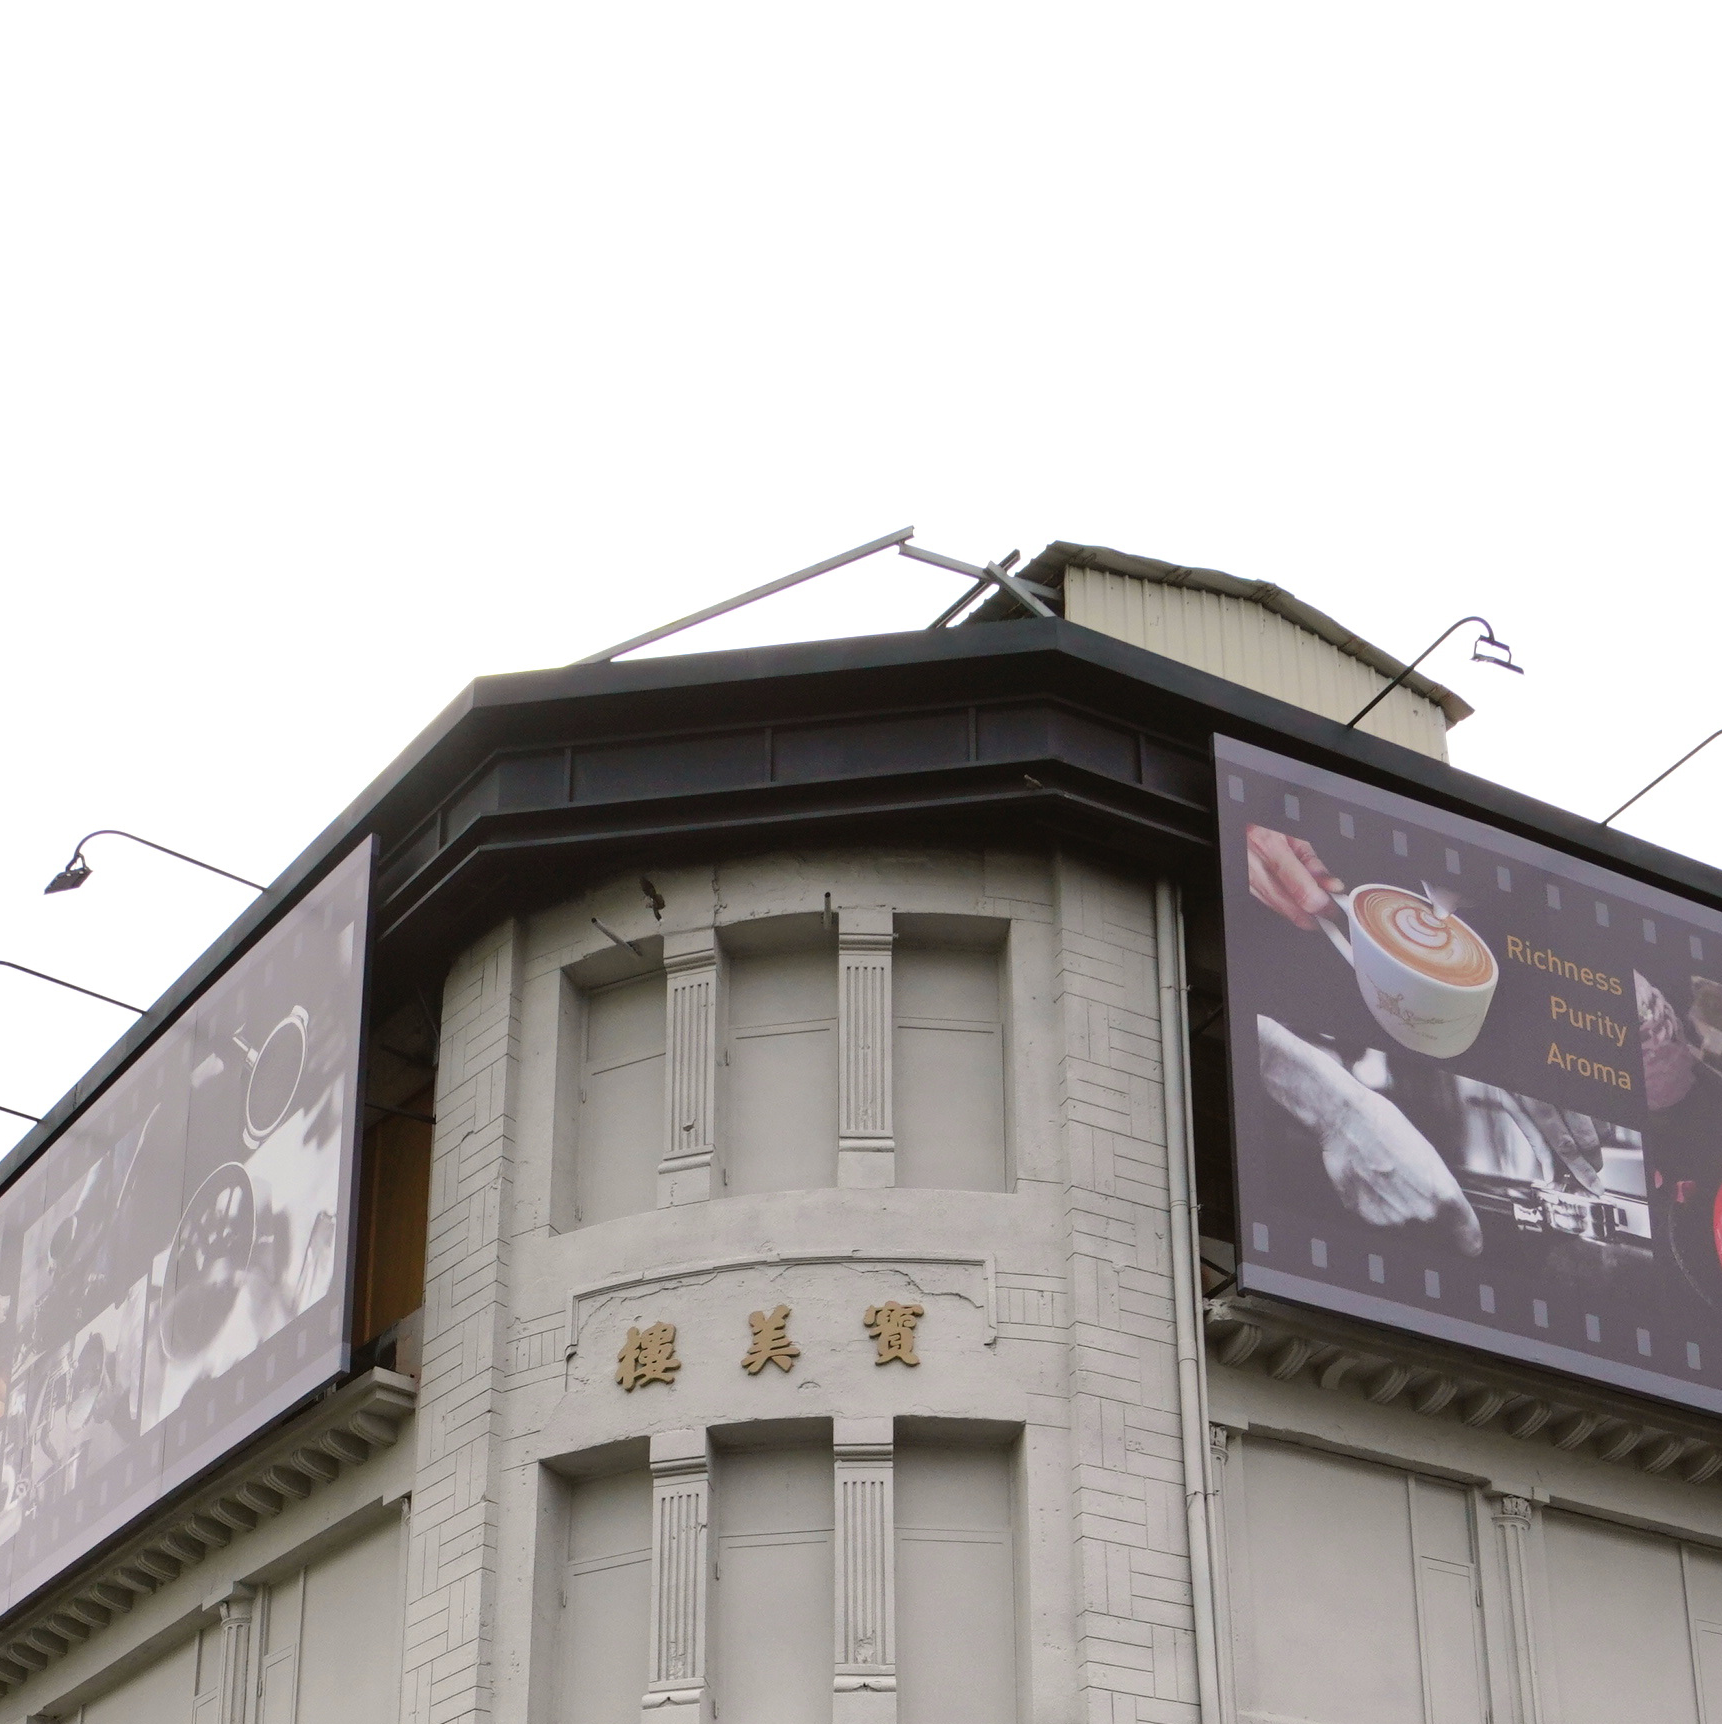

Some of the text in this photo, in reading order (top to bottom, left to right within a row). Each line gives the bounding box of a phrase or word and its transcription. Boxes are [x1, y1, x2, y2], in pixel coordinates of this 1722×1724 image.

[1505, 935, 1623, 996] Richness
[1549, 996, 1628, 1048] Purity
[1547, 1042, 1631, 1091] Aroma
